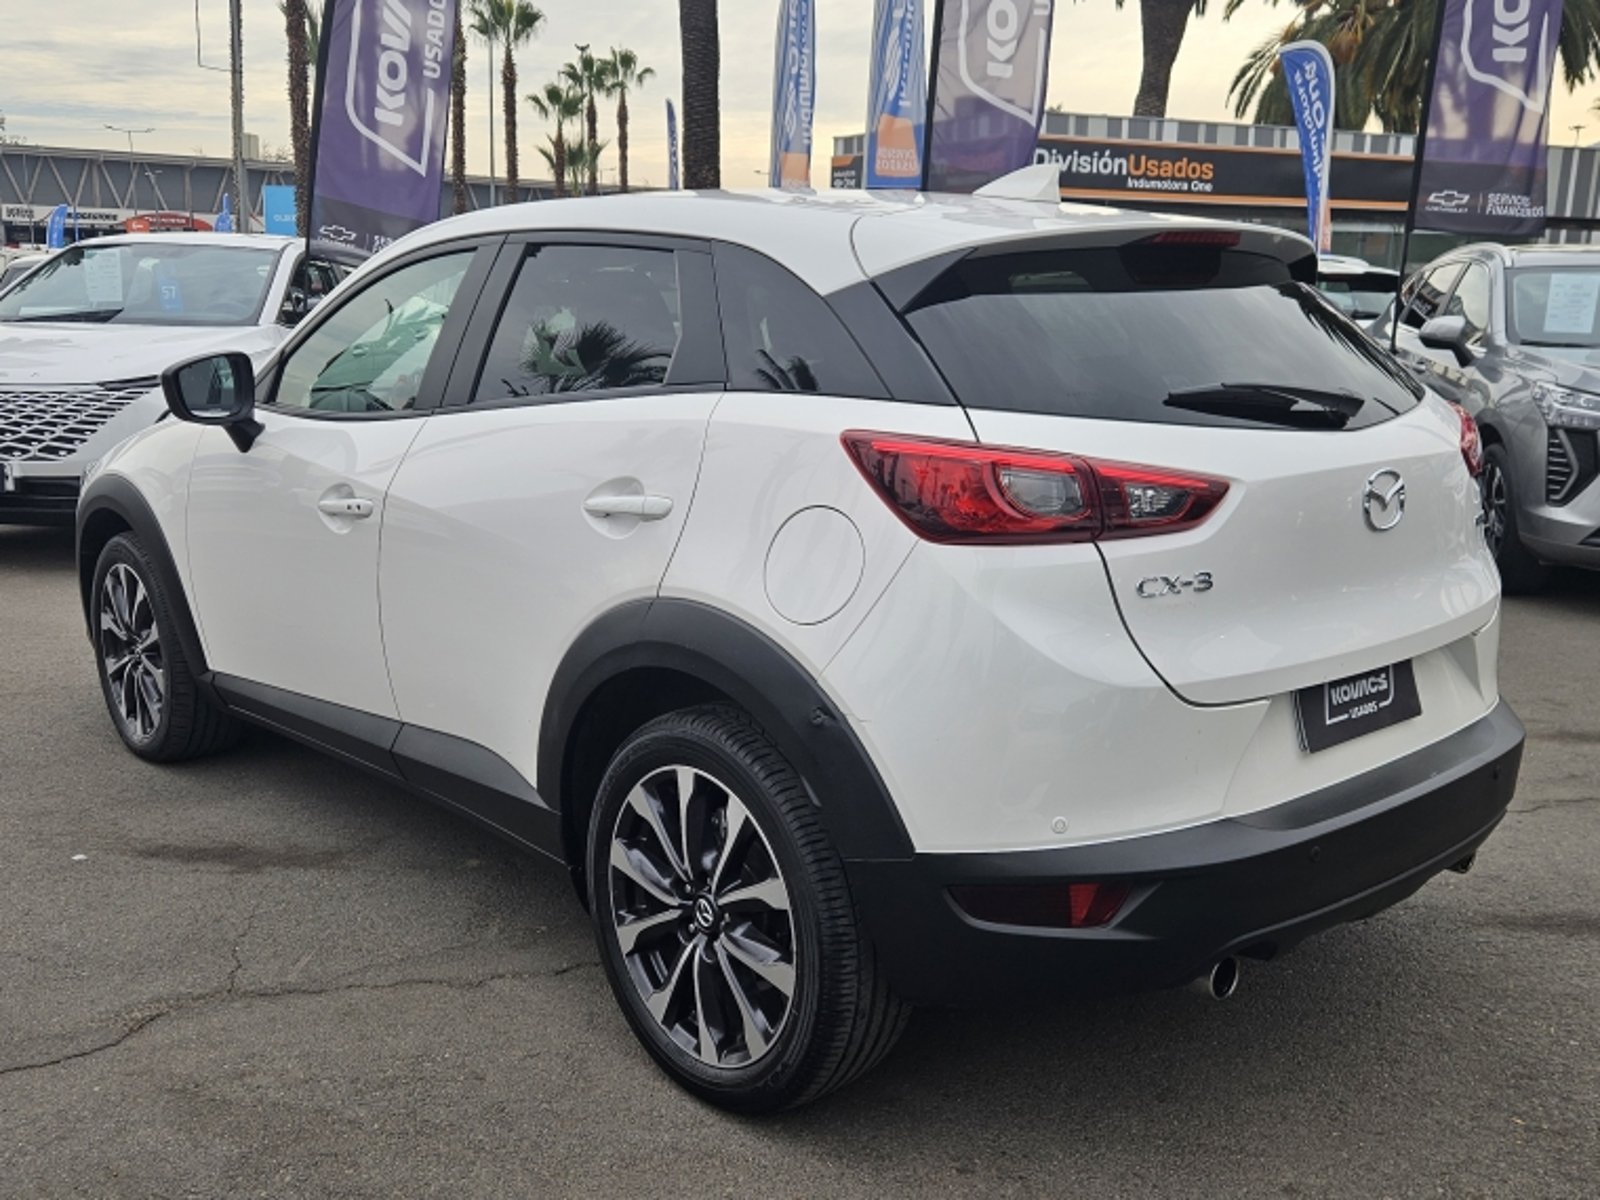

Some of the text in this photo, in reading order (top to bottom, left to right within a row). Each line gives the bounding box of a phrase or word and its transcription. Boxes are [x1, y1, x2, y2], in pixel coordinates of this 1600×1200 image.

[1127, 176, 1214, 192] Indumotora One
[1136, 570, 1213, 598] CX-3
[1330, 673, 1388, 705] KOVACS
